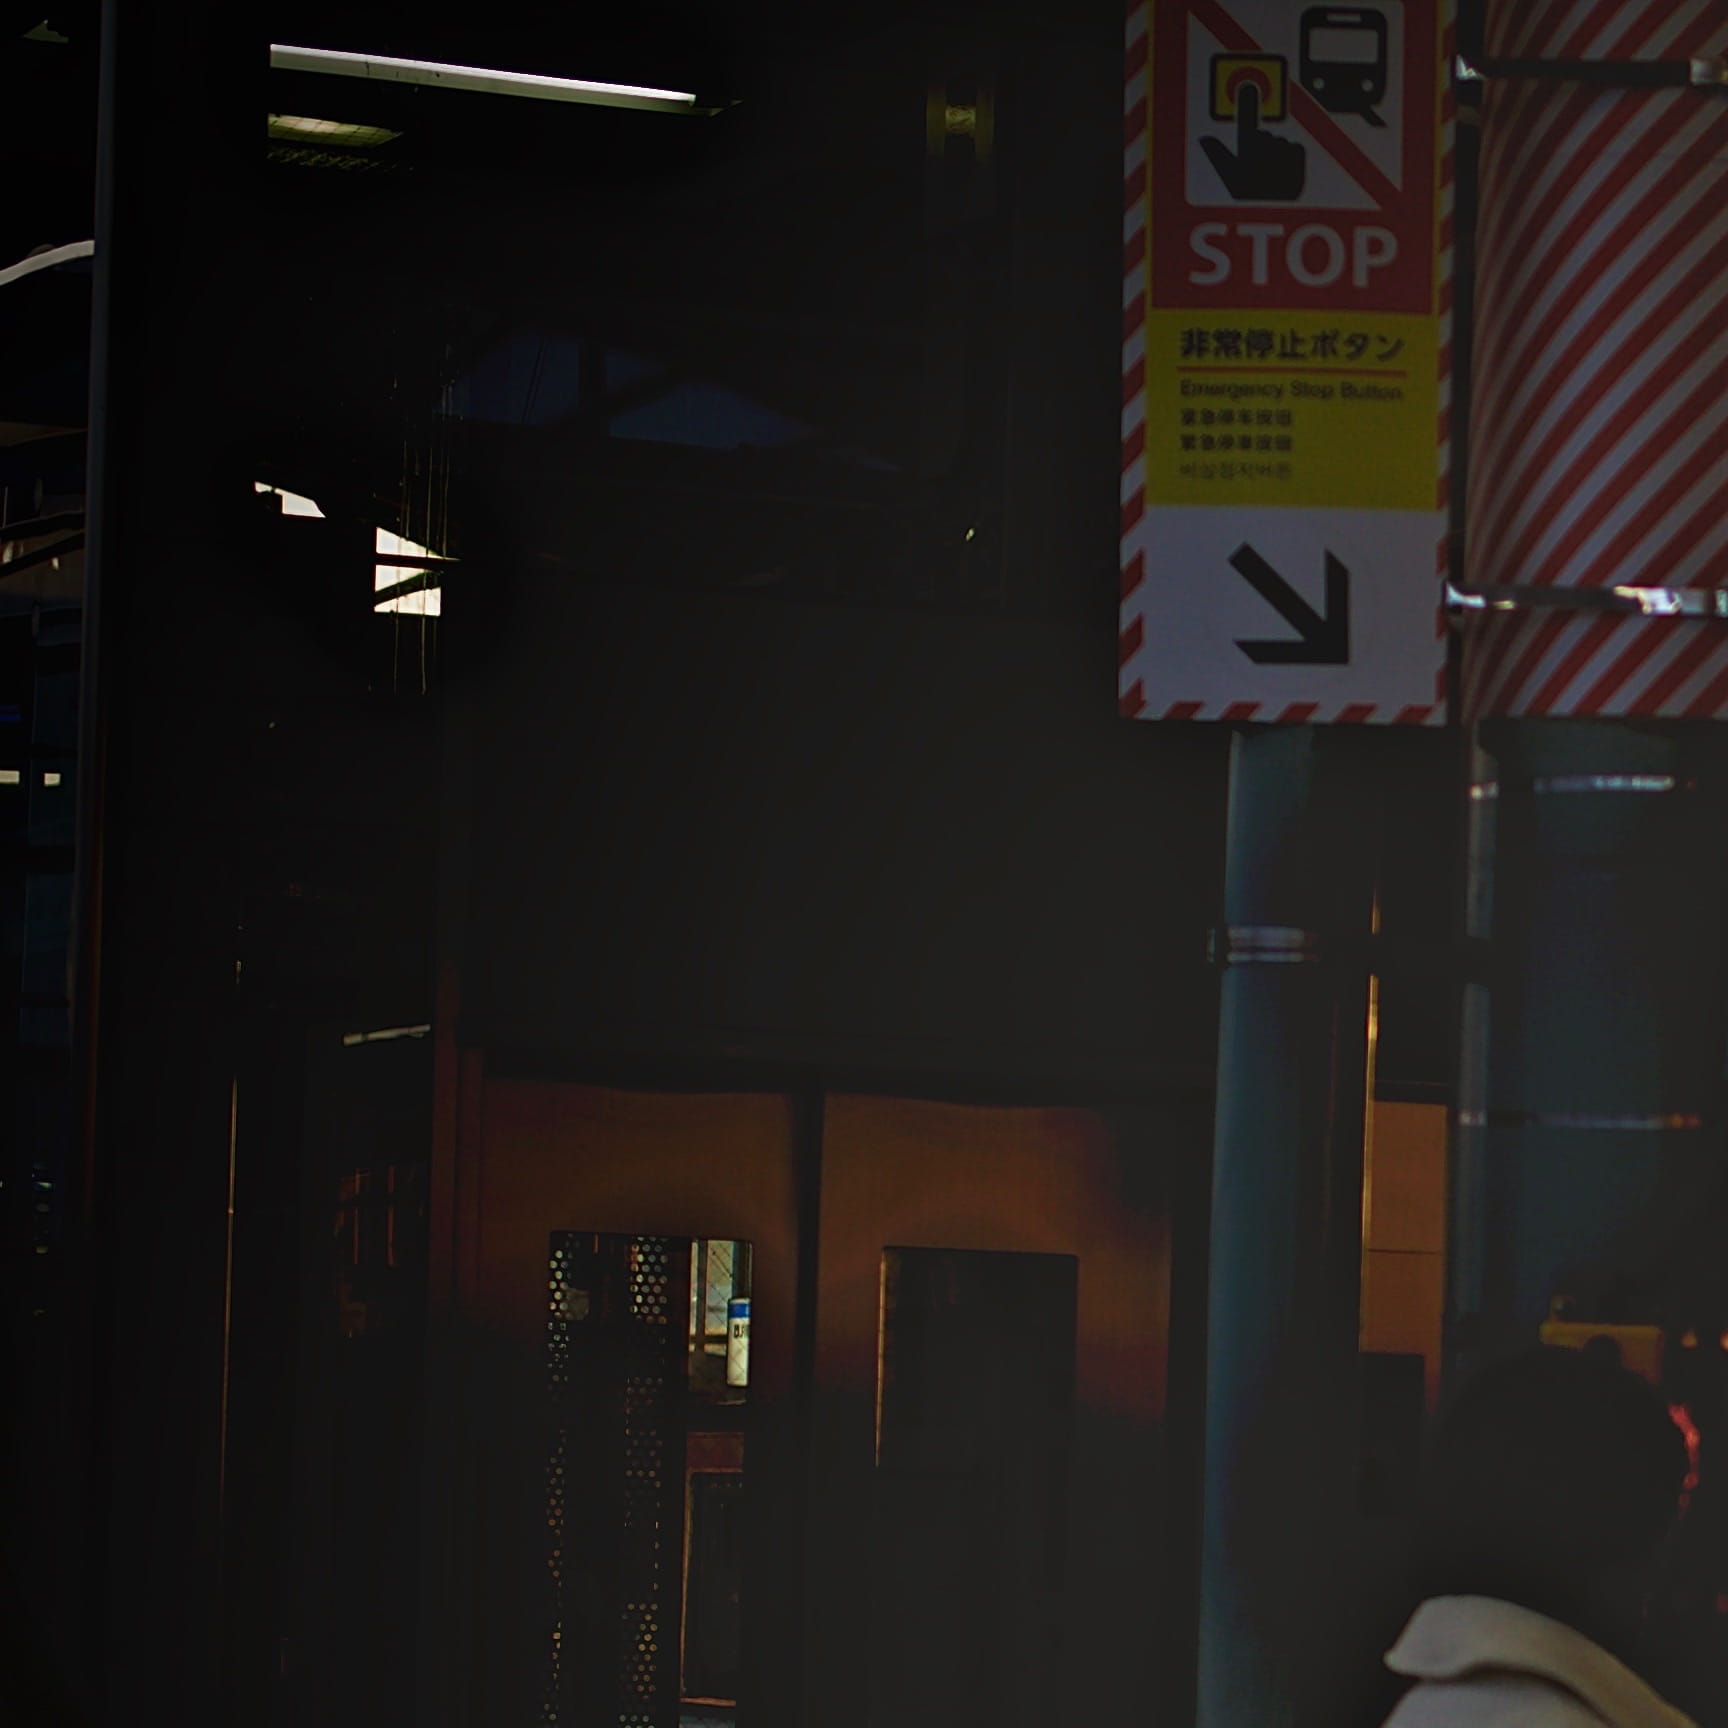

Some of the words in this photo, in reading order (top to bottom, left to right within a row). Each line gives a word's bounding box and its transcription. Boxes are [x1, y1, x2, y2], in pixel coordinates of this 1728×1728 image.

[1188, 222, 1399, 288] STOP
[1180, 327, 1404, 362] 非常停止ボタン
[1180, 379, 1283, 401] Emergency
[1290, 380, 1335, 399] Stop
[1341, 382, 1404, 401] Button
